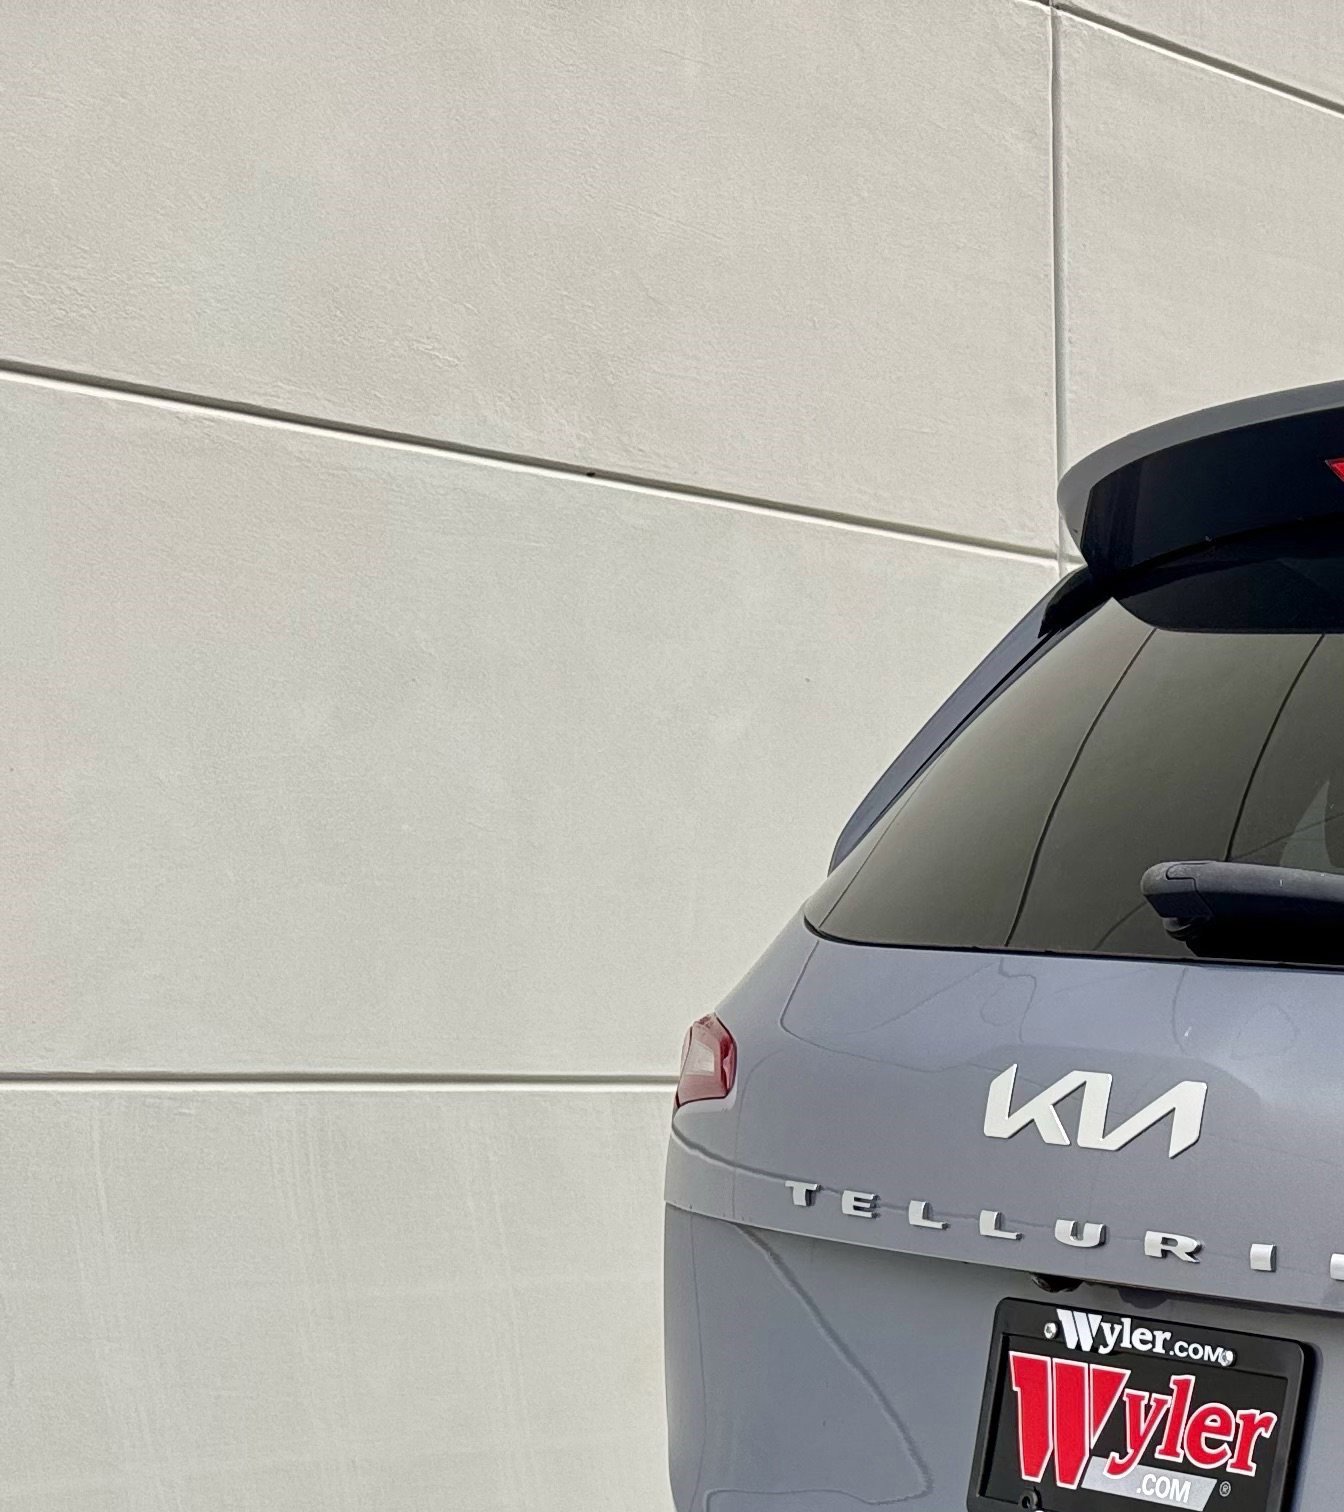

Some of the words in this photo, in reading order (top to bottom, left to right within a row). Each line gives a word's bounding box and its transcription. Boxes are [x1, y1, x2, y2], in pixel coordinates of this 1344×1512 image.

[984, 1064, 1207, 1159] KIA
[1009, 1351, 1277, 1490] Wyler
[1136, 1473, 1192, 1503] .COM
